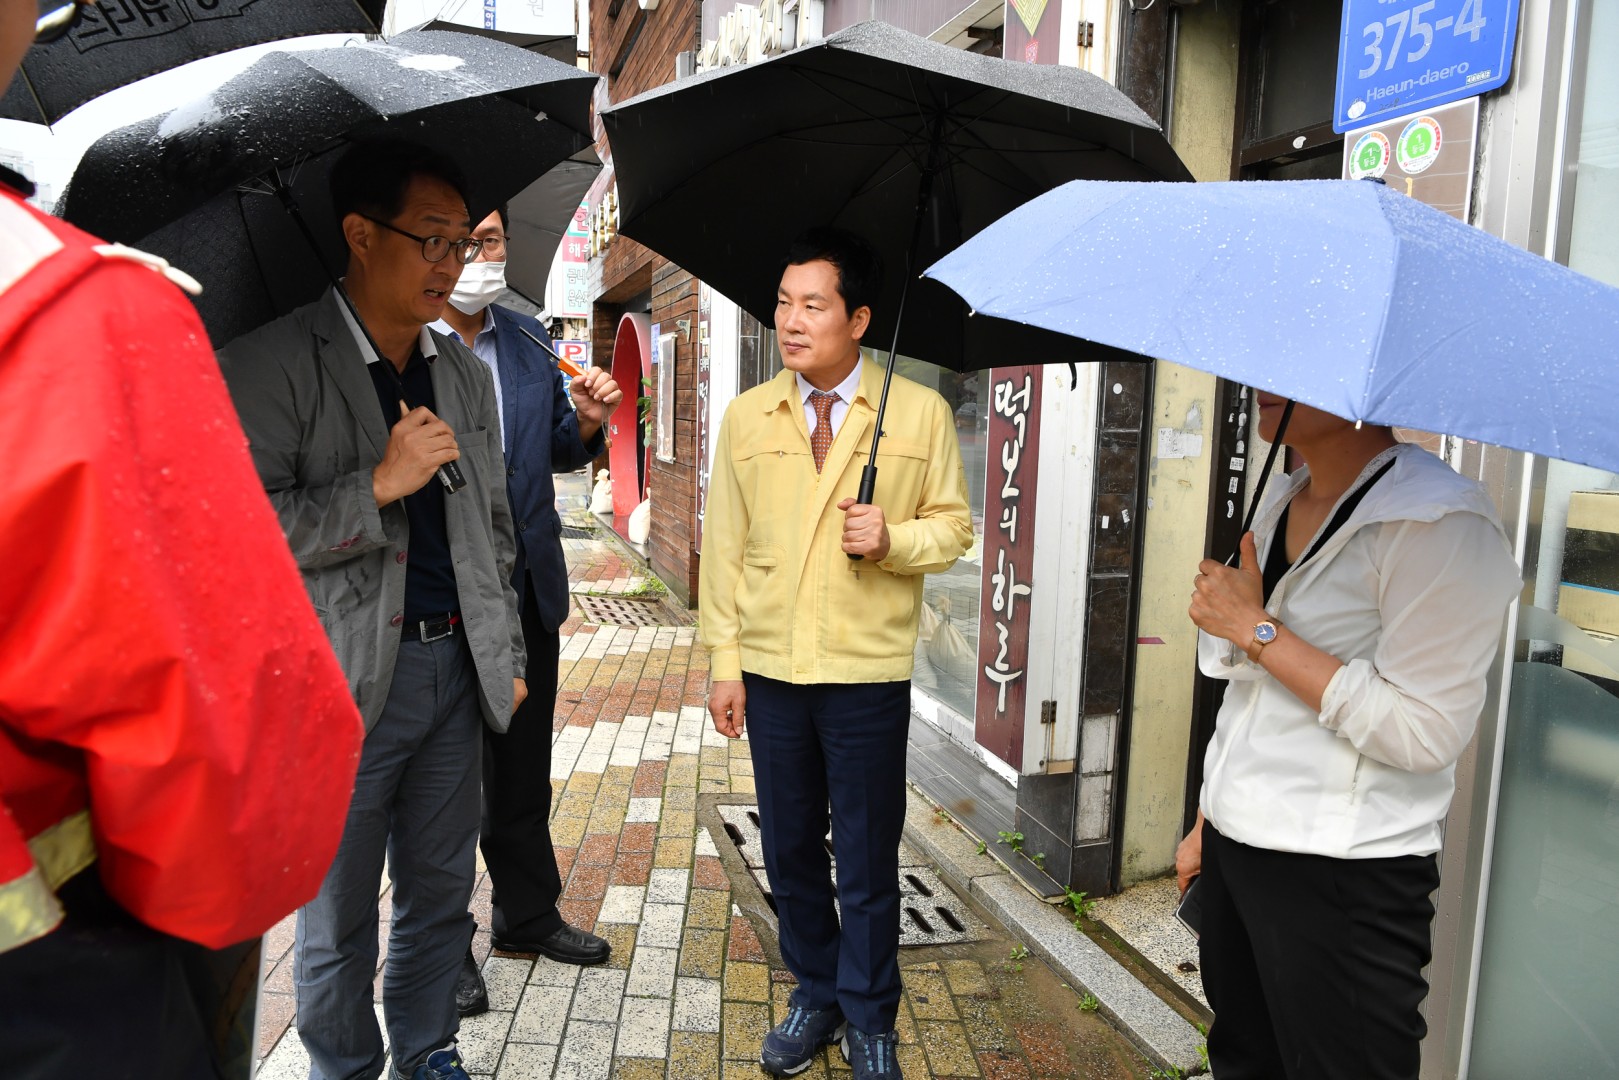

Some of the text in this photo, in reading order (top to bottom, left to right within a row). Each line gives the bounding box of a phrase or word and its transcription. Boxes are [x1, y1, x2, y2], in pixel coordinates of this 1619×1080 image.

[1358, 0, 1487, 80] 375-4
[1366, 61, 1470, 102] Haeun-daero
[564, 344, 582, 361] P
